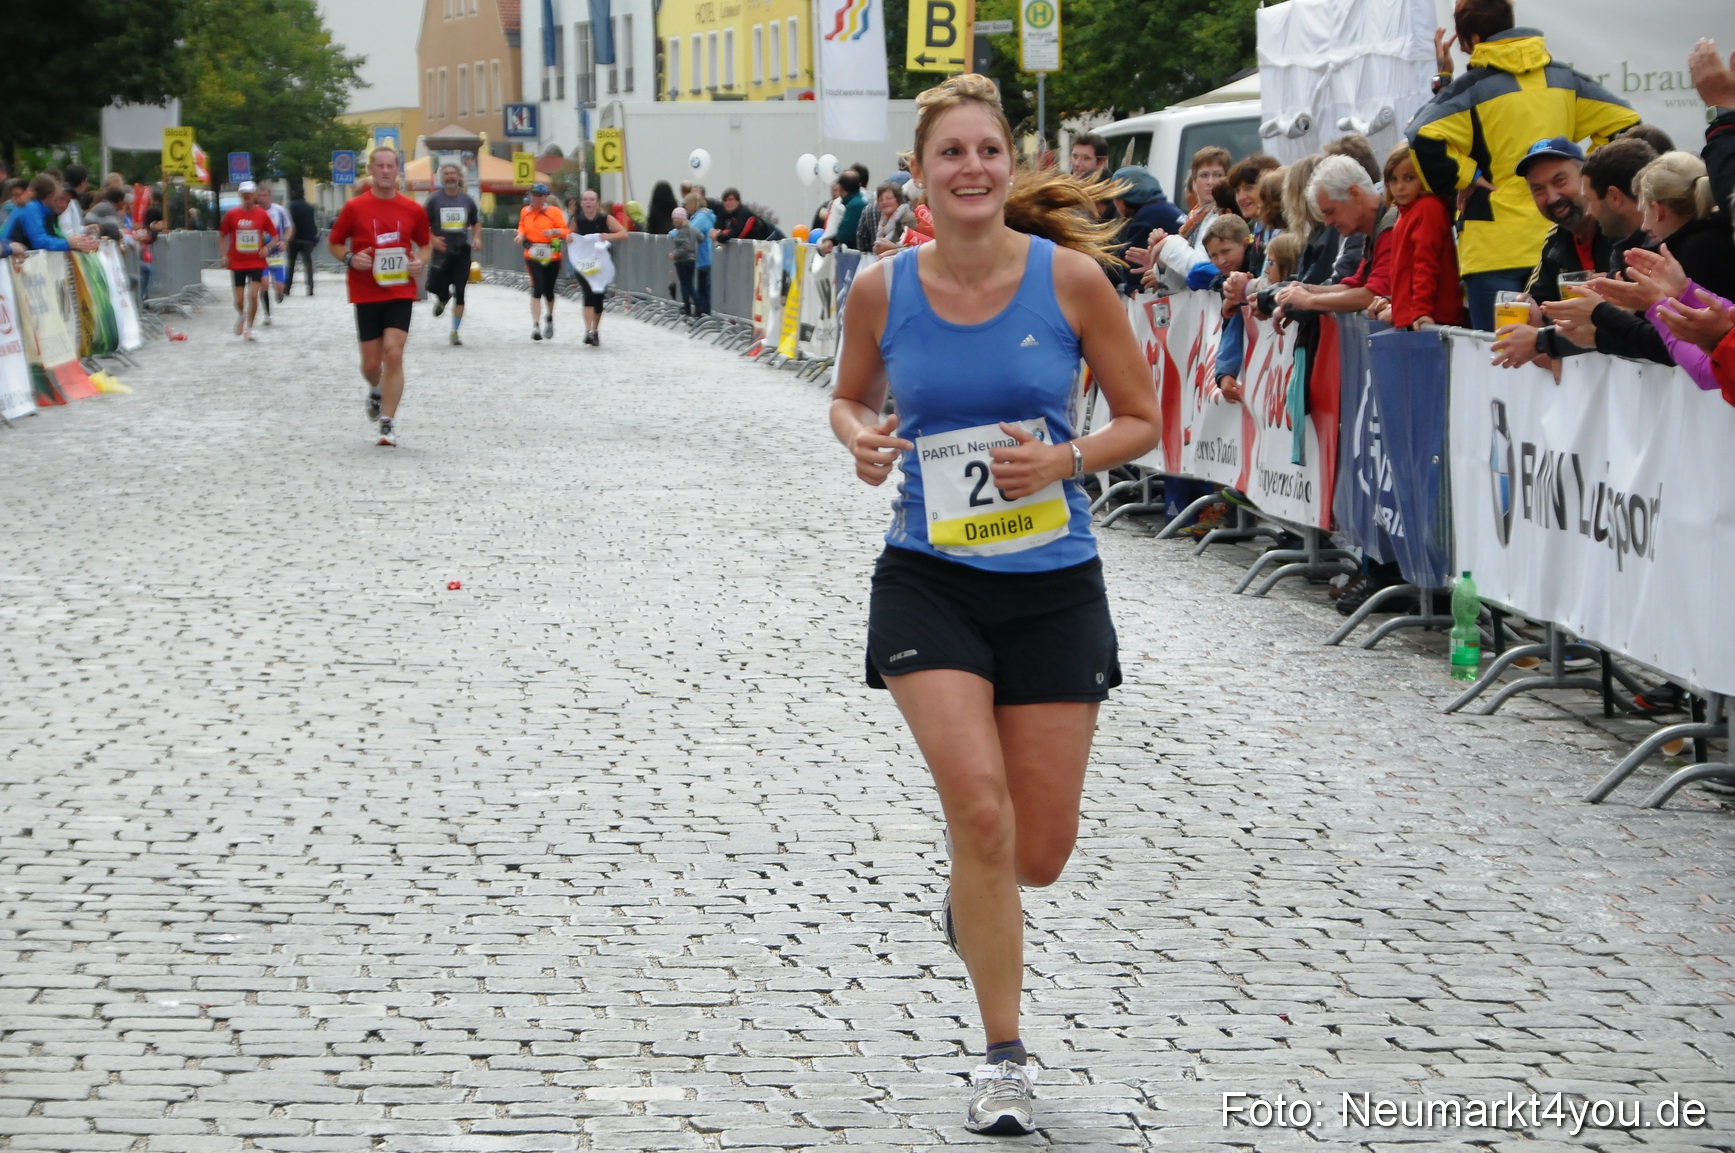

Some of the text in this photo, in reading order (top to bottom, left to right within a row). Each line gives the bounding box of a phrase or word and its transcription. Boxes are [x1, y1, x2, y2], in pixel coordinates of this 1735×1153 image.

[925, 1, 957, 48] B
[169, 140, 185, 162] C
[601, 141, 617, 163] C
[518, 162, 530, 178] D
[380, 256, 404, 271] 207
[922, 443, 965, 462] PARTL
[964, 513, 1034, 541] Daniela
